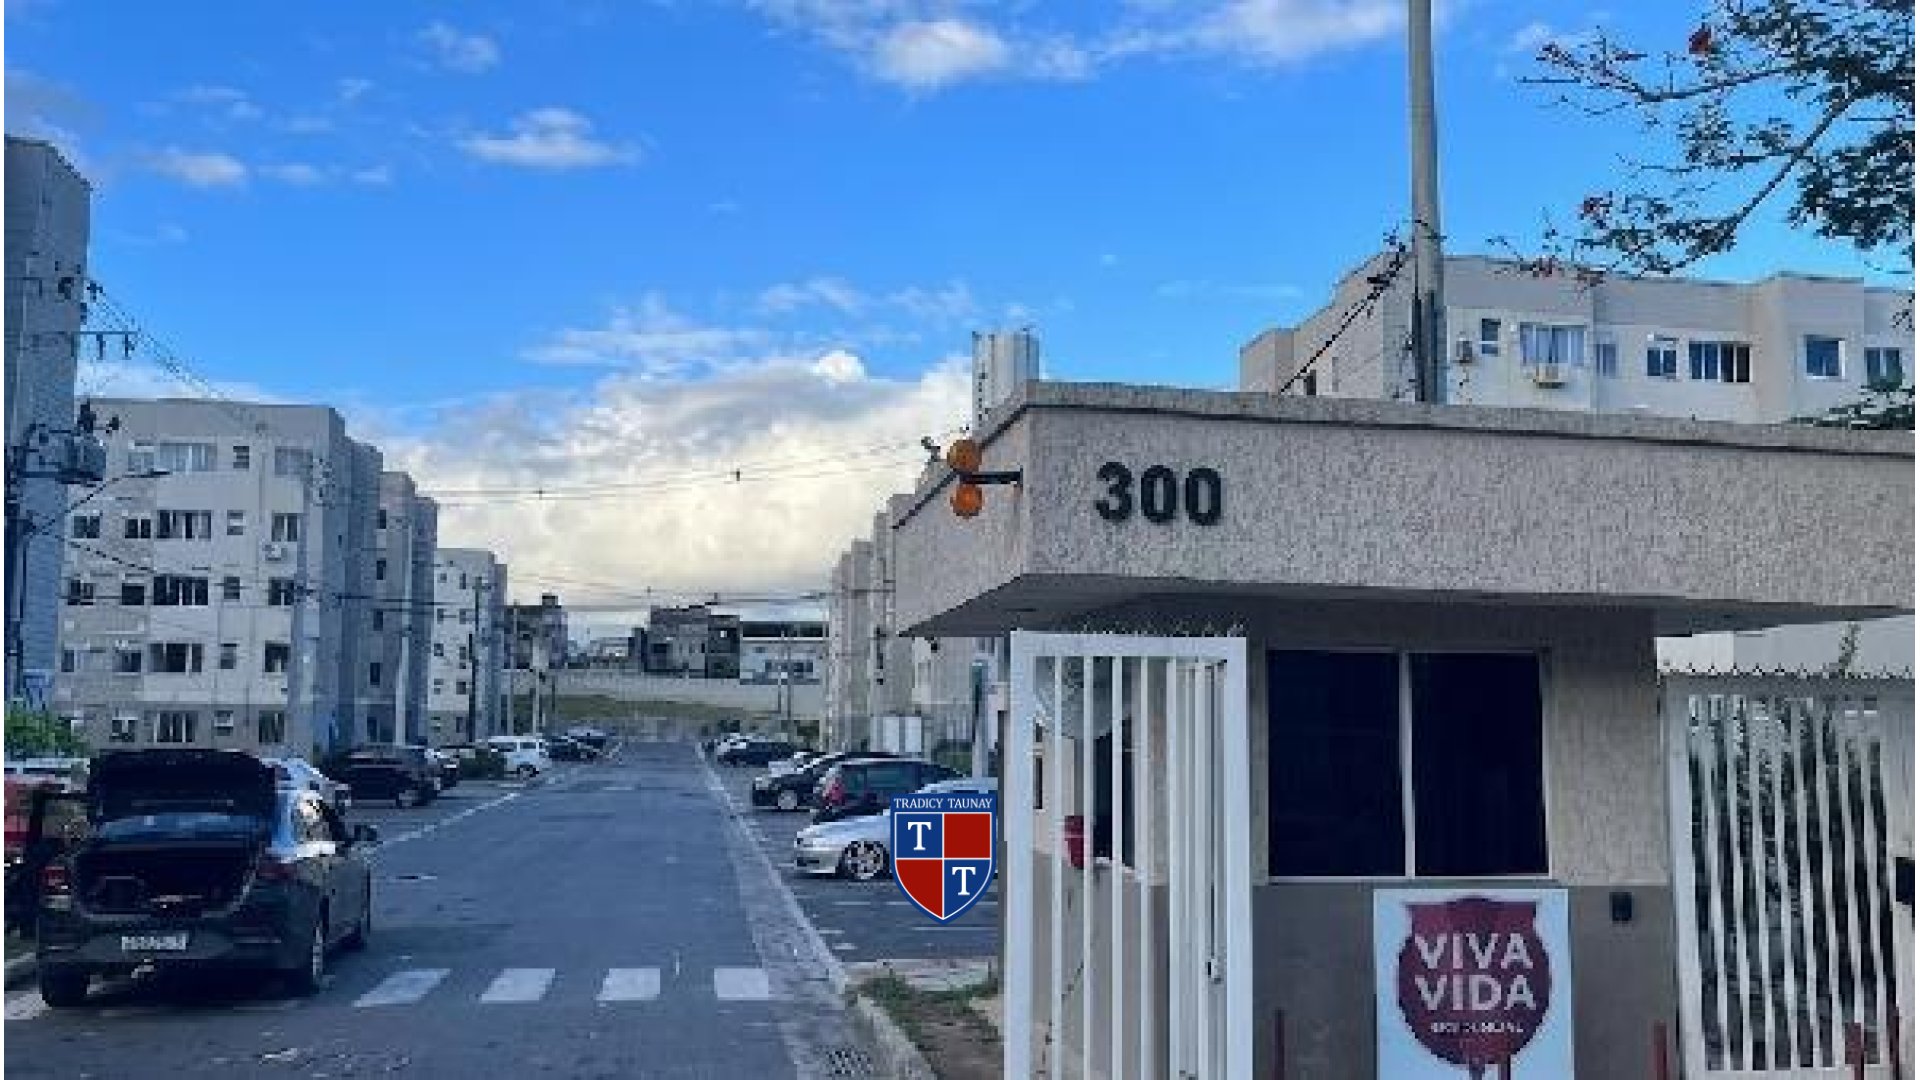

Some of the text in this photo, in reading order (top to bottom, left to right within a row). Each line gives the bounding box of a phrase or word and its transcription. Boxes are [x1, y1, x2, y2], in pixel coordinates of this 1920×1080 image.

[1096, 462, 1222, 526] 300
[1414, 933, 1534, 970] VIVA
[1414, 974, 1537, 1011] VIDA
